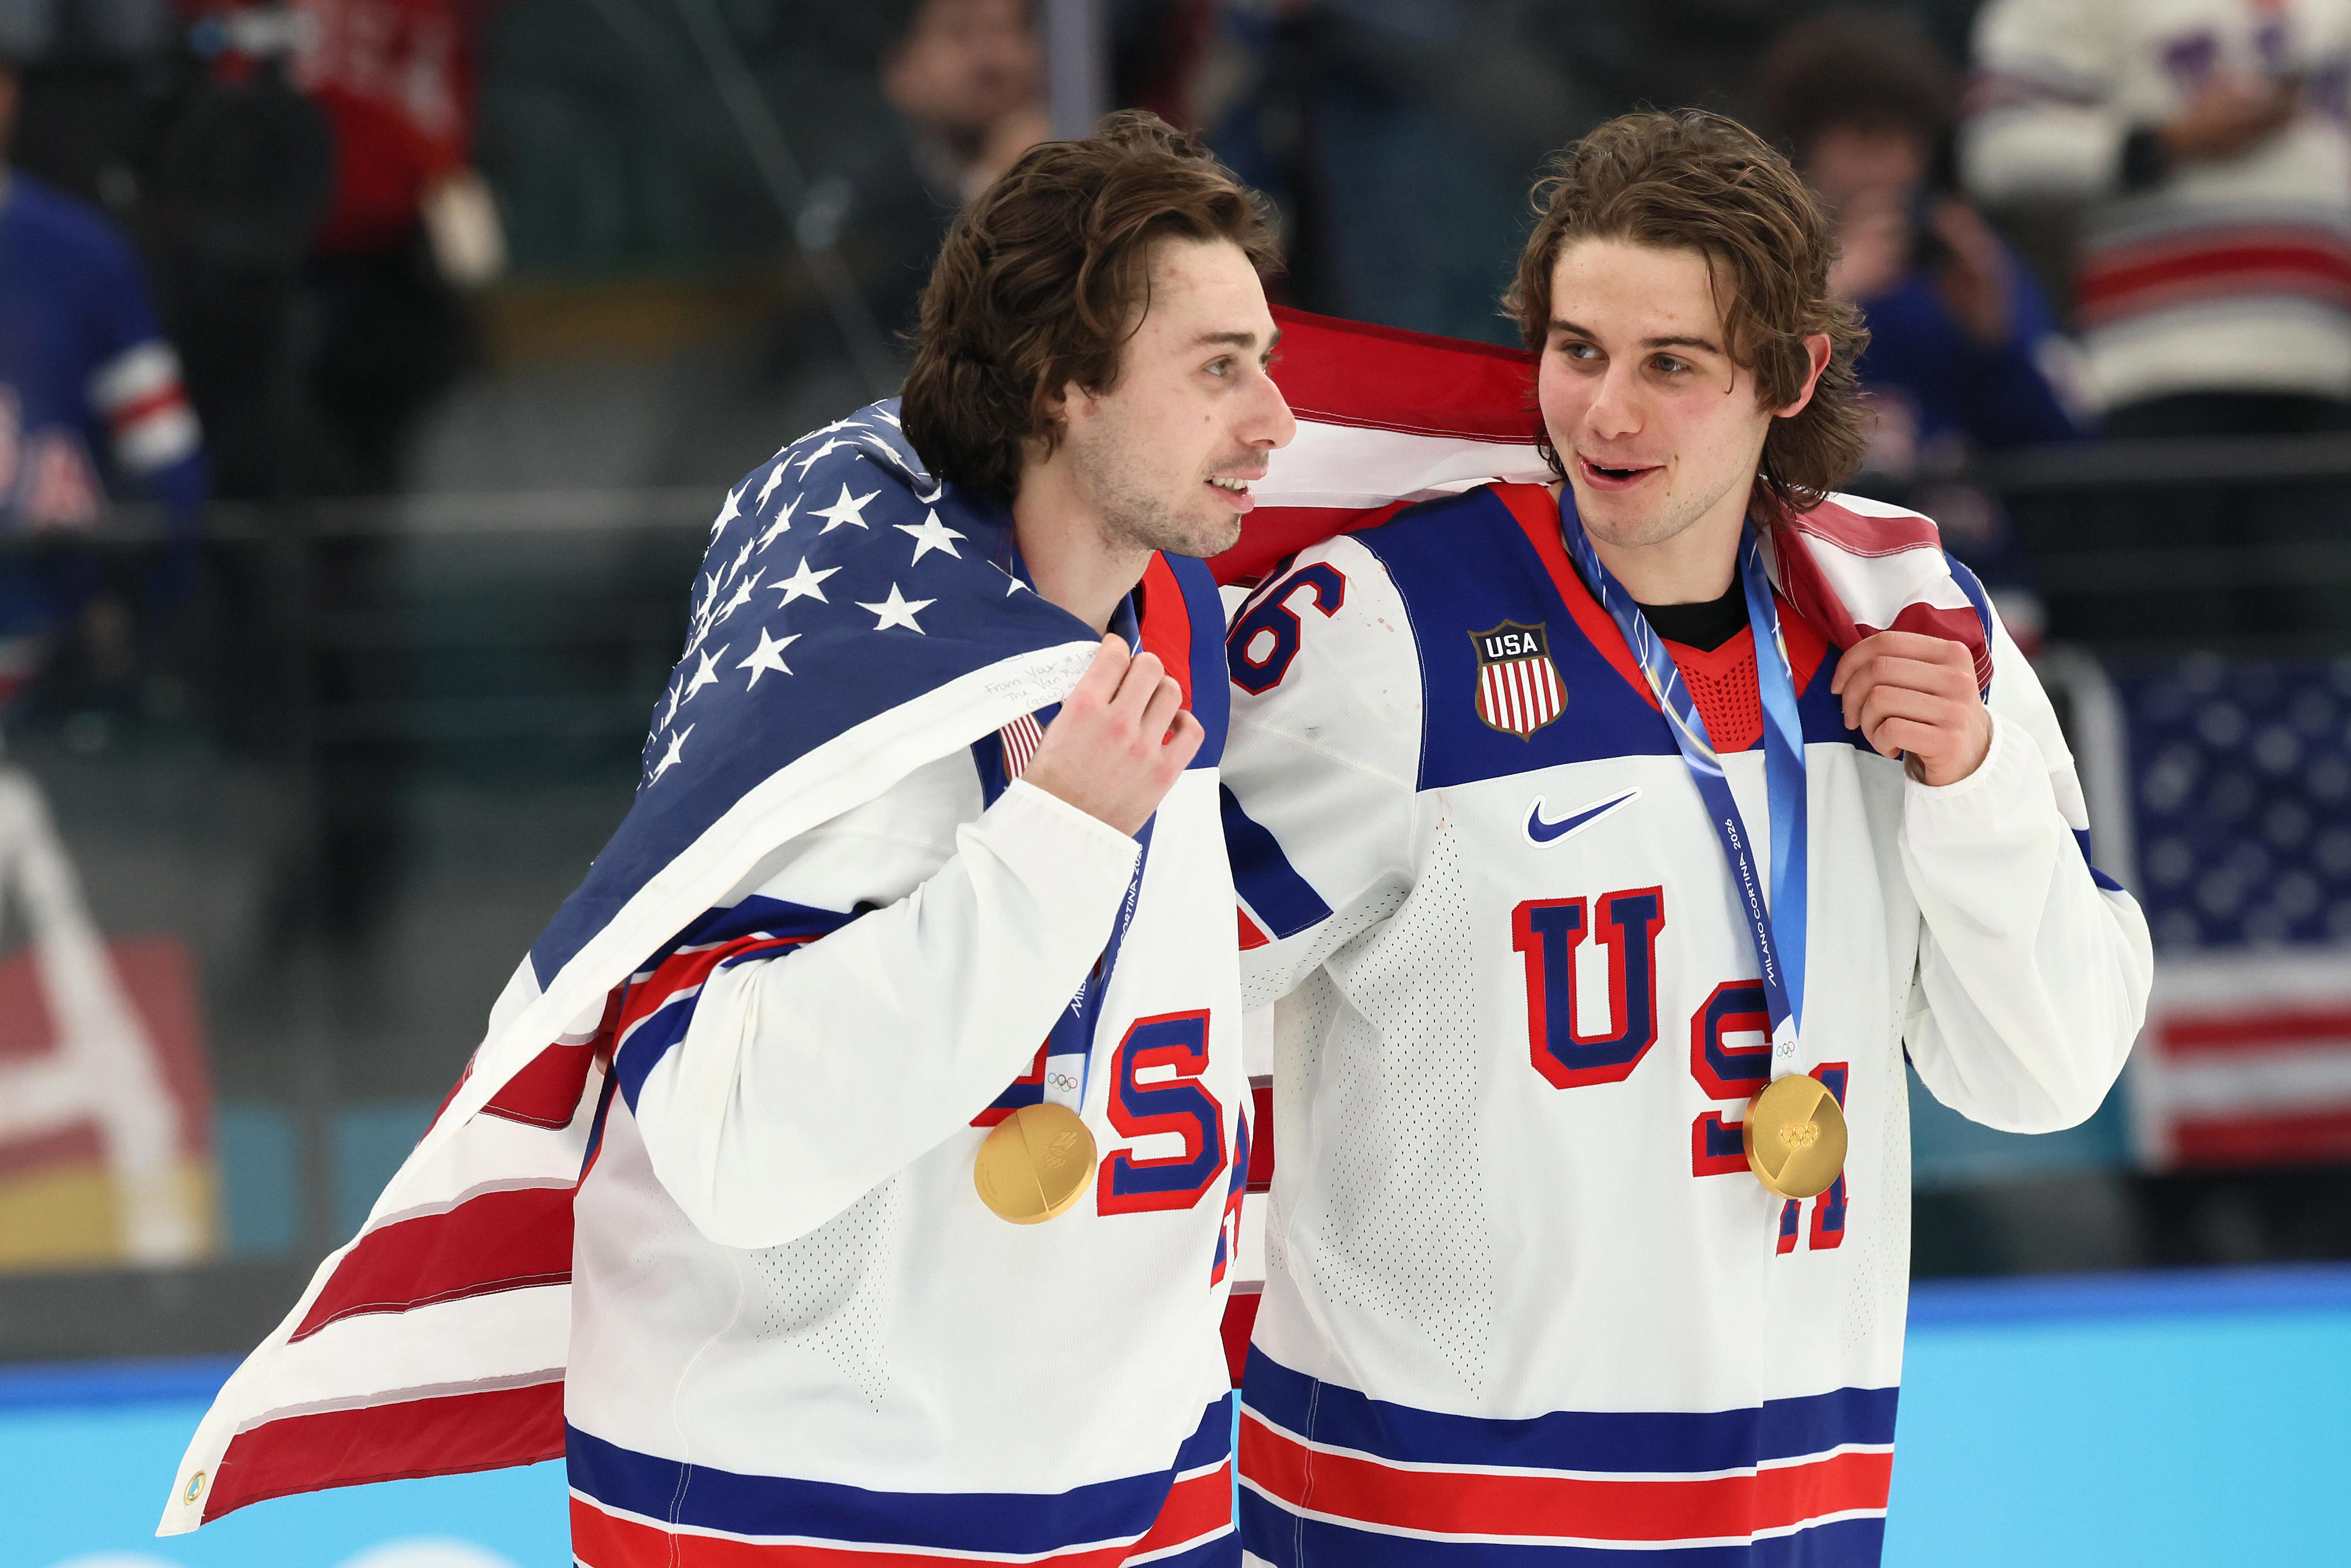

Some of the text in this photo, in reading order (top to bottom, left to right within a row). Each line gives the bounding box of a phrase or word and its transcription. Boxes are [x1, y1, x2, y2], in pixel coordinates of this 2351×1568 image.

[1486, 632, 1538, 658] USA
[984, 679, 1022, 694] From
[1002, 690, 1030, 701] The
[1033, 677, 1061, 689] Van
[1724, 818, 1776, 987] MILANO CORTINA 2026
